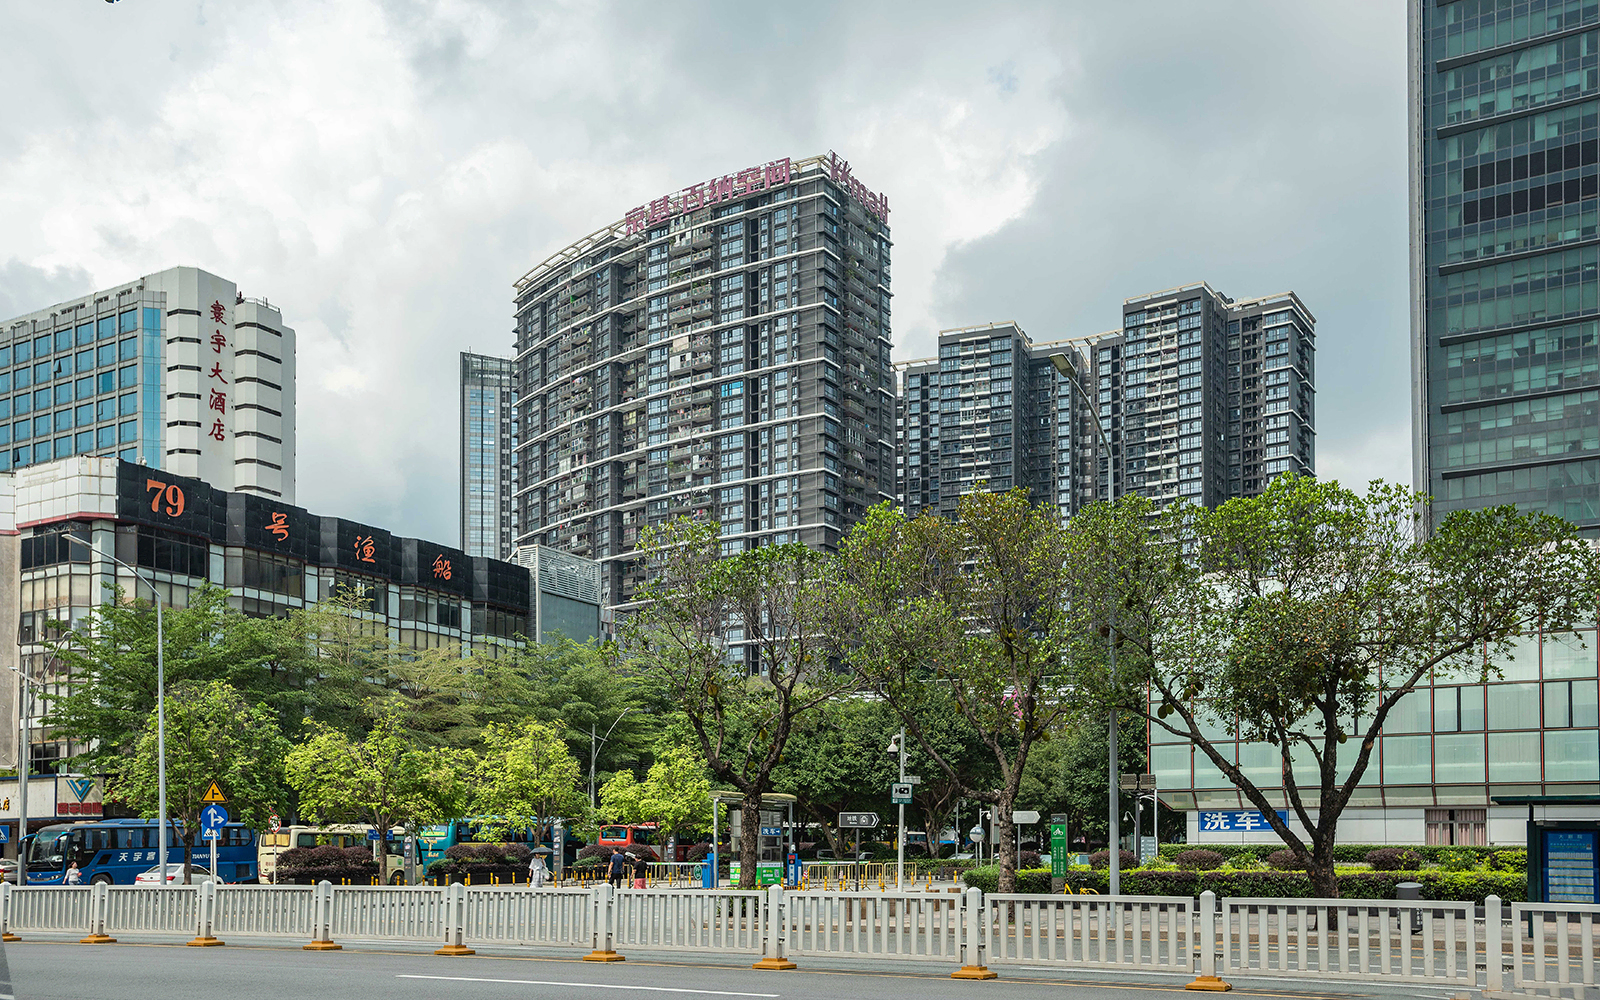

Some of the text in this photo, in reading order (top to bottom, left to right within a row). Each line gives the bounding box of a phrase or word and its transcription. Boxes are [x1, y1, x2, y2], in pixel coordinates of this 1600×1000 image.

[830, 152, 888, 224] kkmall
[208, 300, 228, 441] 寰宇大酒店
[1204, 811, 1260, 830] 洗车
